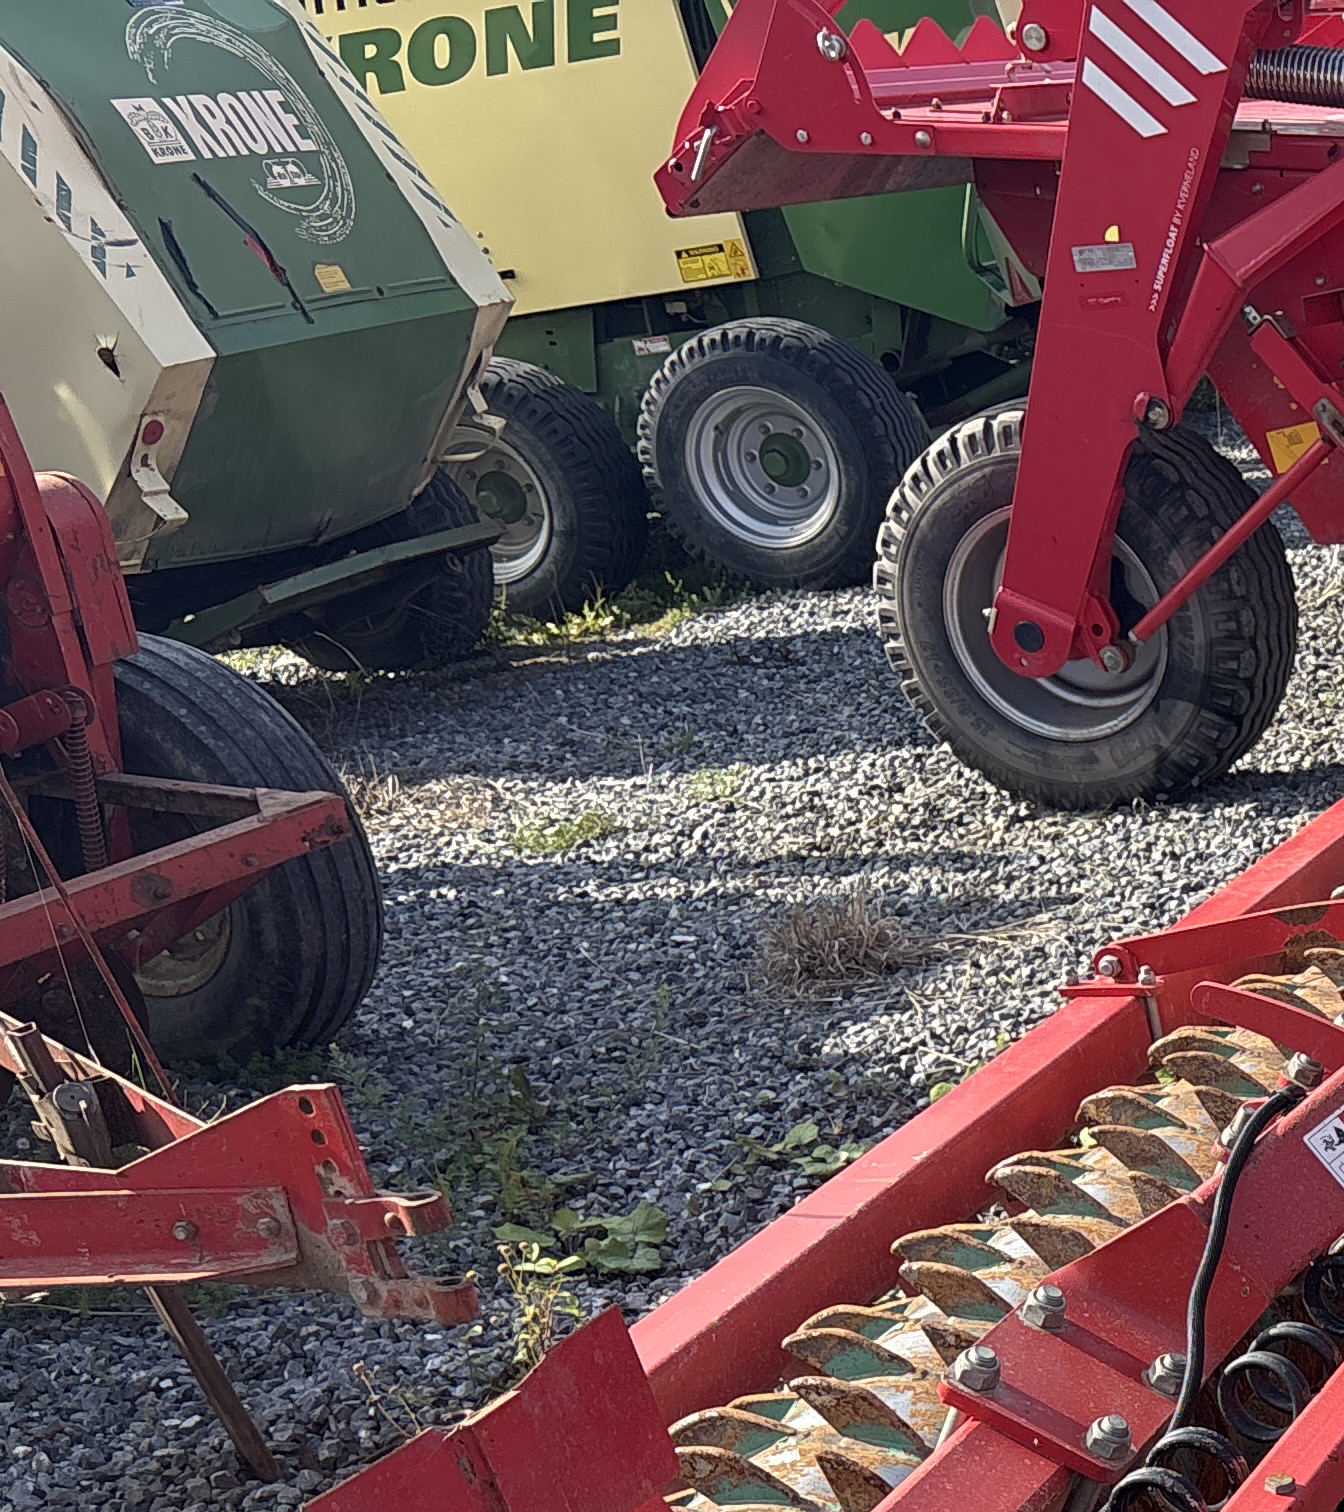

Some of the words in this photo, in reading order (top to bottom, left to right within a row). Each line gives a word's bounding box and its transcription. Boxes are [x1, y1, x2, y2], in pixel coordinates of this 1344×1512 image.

[325, 0, 621, 95] RONE
[151, 144, 189, 158] KRONE
[161, 90, 318, 159] KRONE
[1153, 224, 1179, 292] SUPERFLOAT
[1172, 209, 1183, 226] BY
